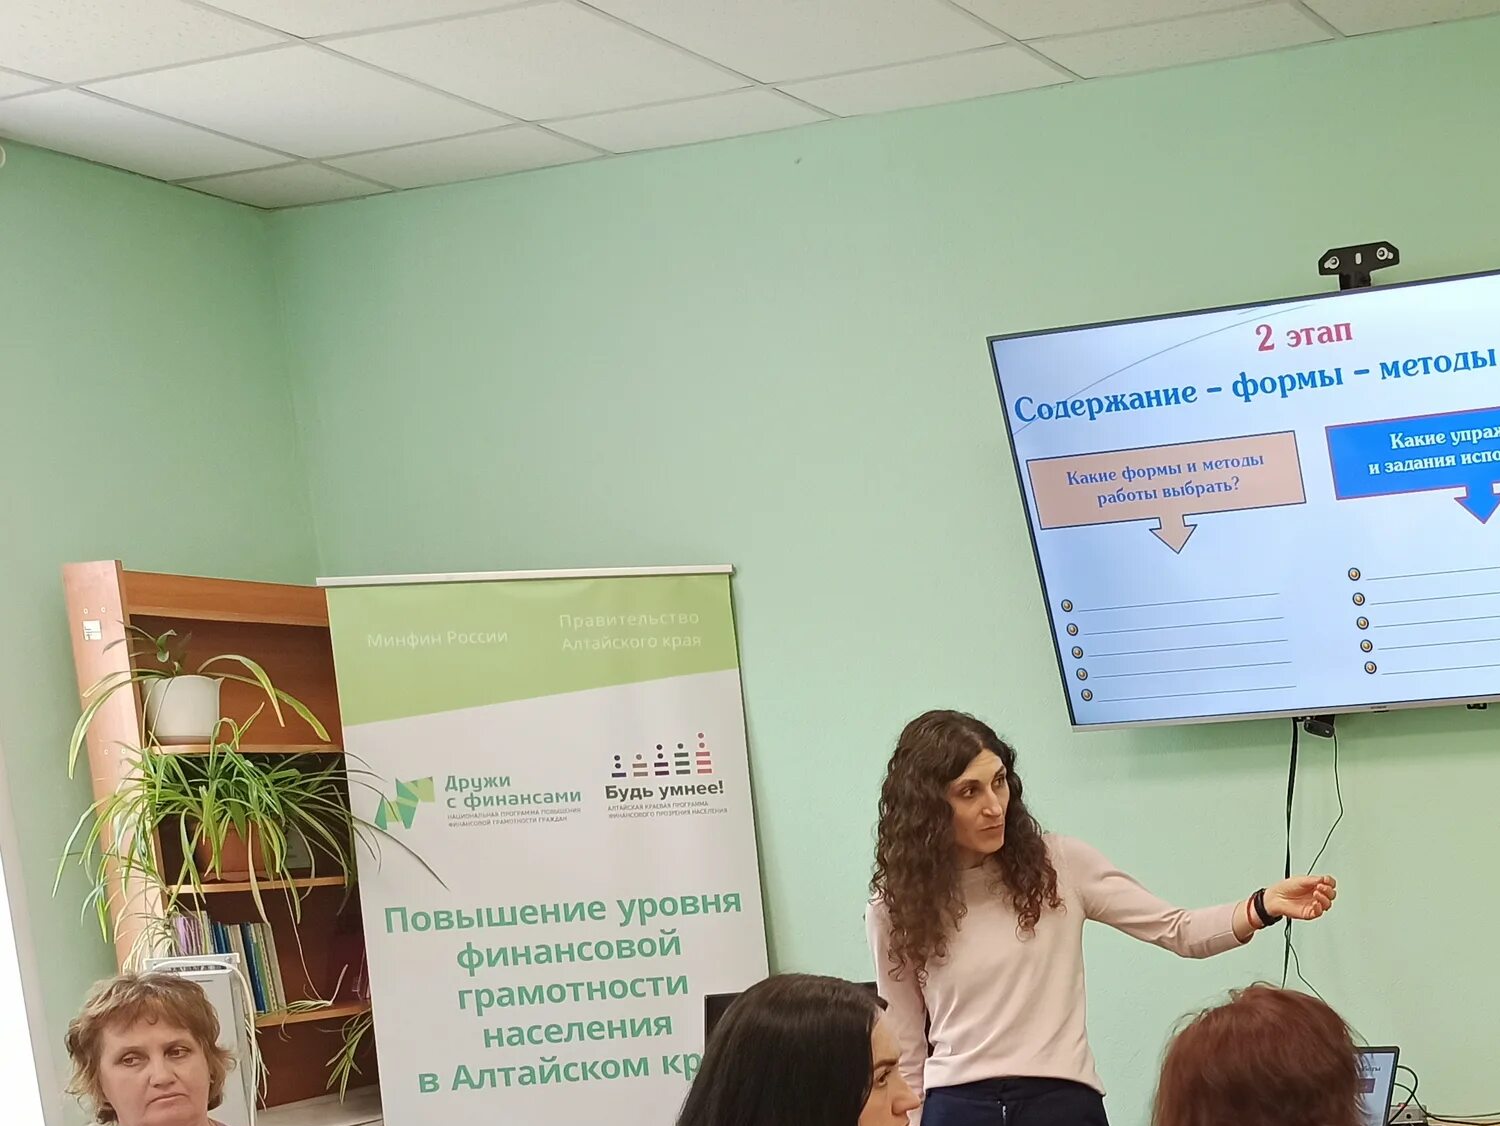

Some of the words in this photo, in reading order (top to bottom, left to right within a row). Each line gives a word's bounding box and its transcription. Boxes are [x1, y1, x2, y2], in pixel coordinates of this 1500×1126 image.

[1256, 324, 1275, 351] 2
[1286, 322, 1353, 349] этап
[1014, 385, 1198, 422] Содержание
[1231, 366, 1344, 403] формы
[1379, 349, 1497, 380] методы
[1389, 431, 1446, 450] Какие
[1066, 469, 1117, 487] Какие
[1121, 463, 1182, 483] формы
[1187, 462, 1197, 473] и
[1202, 454, 1265, 472] методы
[1368, 462, 1379, 475] и
[1384, 453, 1456, 474] задания
[1097, 487, 1158, 508] работы
[1162, 475, 1240, 499] выбрать?
[559, 612, 699, 630] Правительство
[367, 630, 442, 649] Минфин
[447, 629, 508, 645] России
[561, 635, 657, 651] Алтайского
[662, 634, 702, 650] края
[445, 775, 511, 793] Дружи
[605, 785, 654, 802] Будь
[659, 780, 724, 801] умнее!
[446, 797, 456, 809] с
[464, 791, 582, 811] финансами
[384, 897, 607, 933] Повышение
[617, 890, 742, 925] уровня
[456, 929, 682, 976] финансовой
[458, 974, 689, 1016] грамотности
[483, 1015, 673, 1048] населения
[418, 1072, 440, 1093] в
[452, 1052, 650, 1091] Алтайском
[662, 1051, 701, 1082] кр
